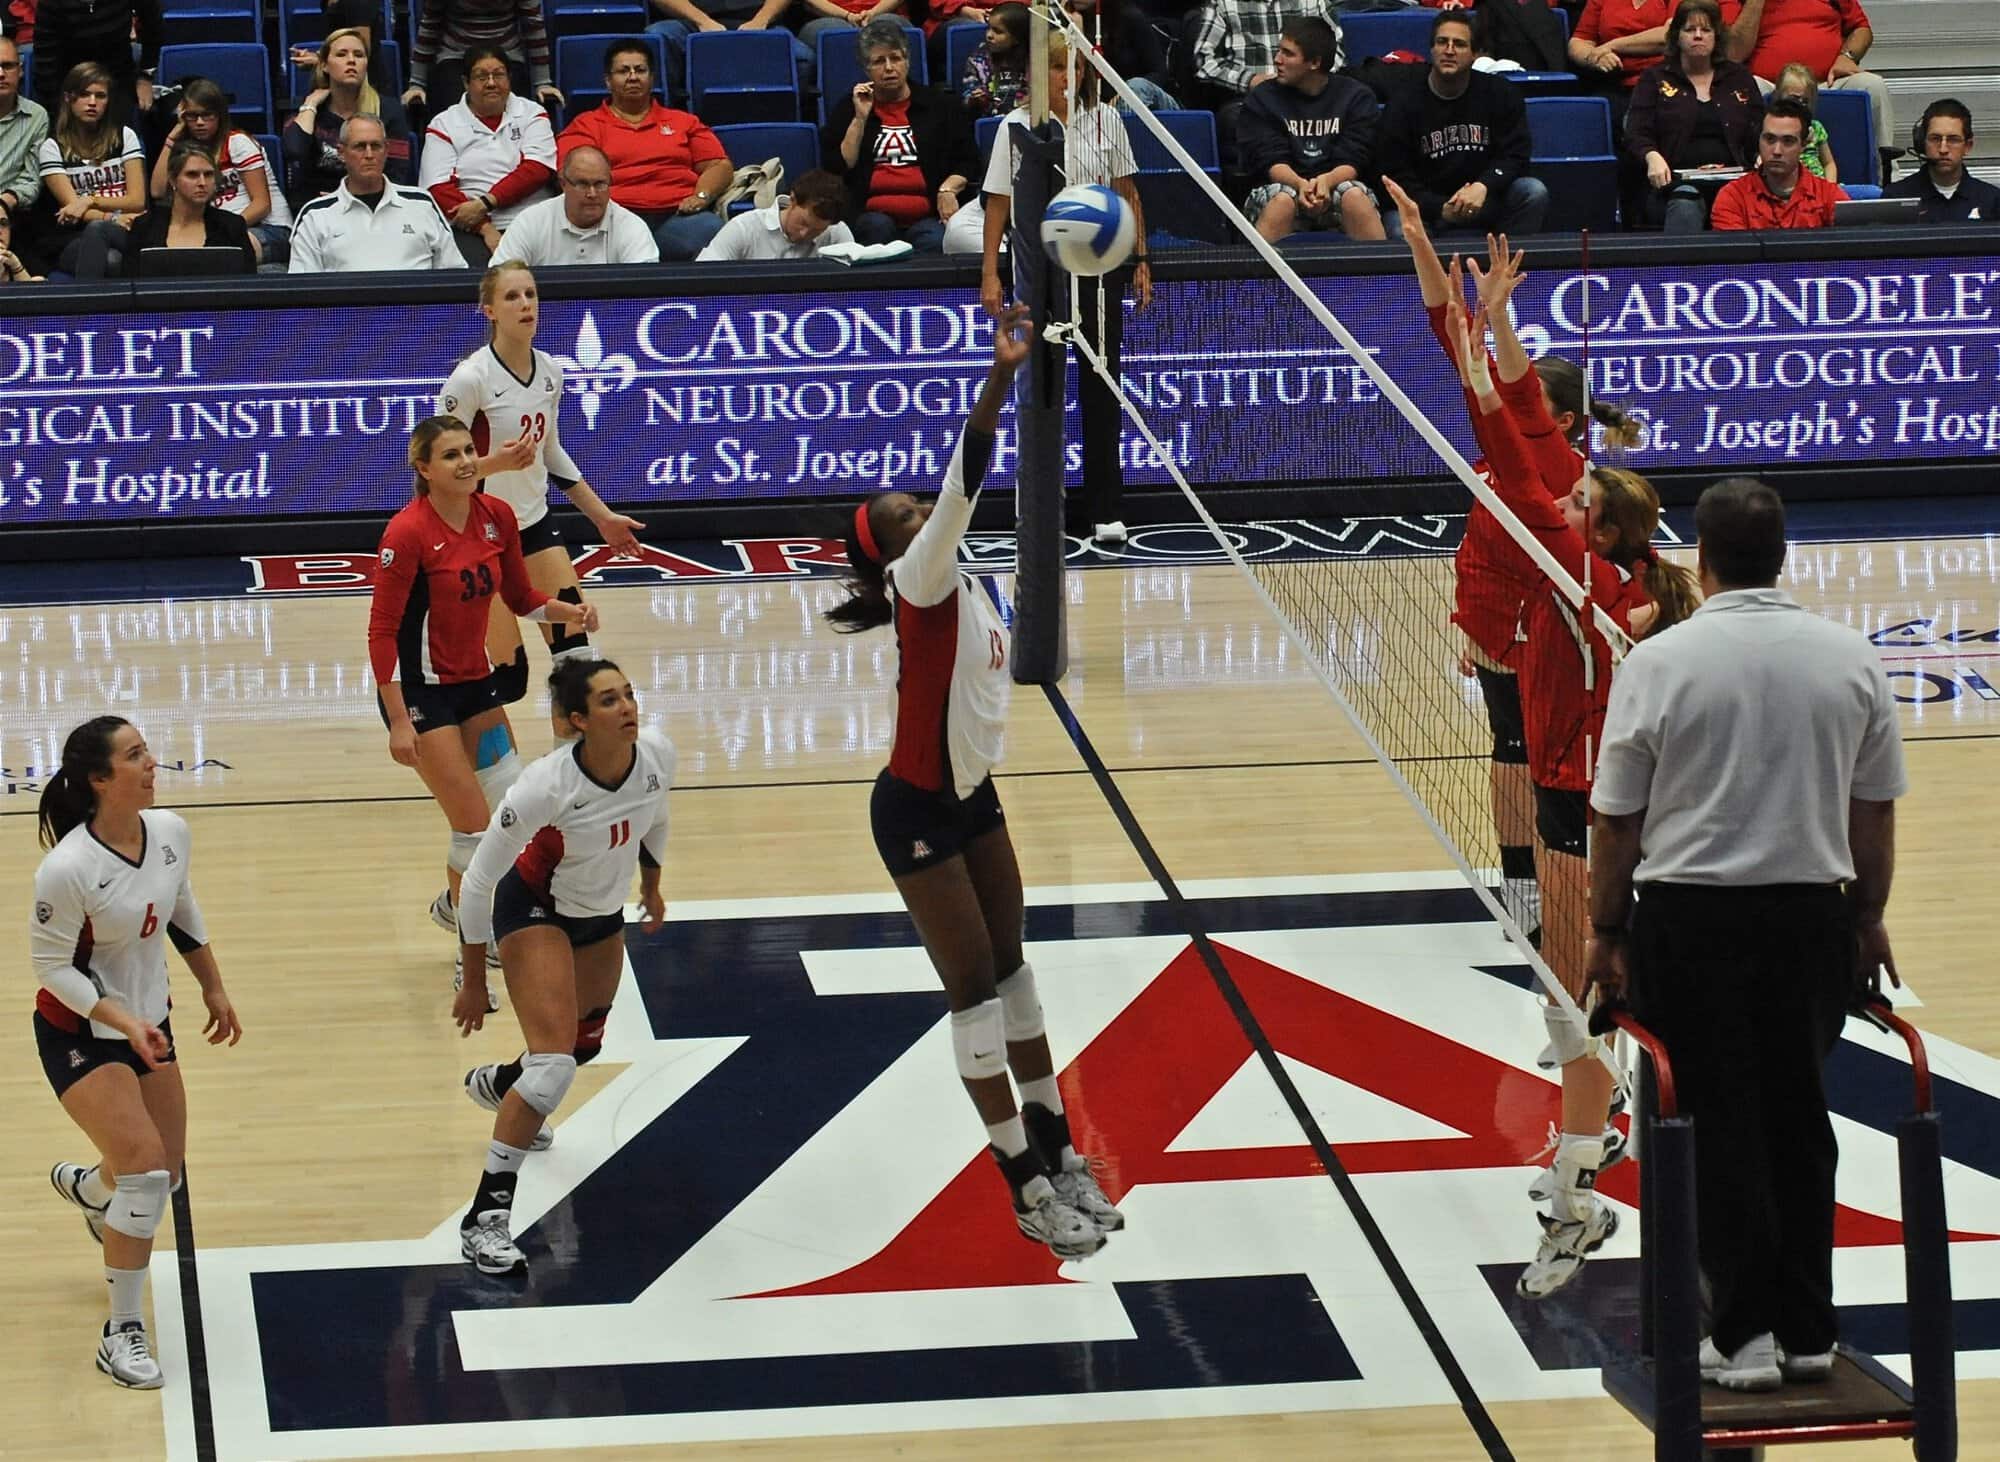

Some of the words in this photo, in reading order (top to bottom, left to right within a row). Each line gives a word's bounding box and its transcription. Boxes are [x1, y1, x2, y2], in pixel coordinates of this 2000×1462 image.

[1120, 365, 1381, 408] NSTITUTE
[167, 394, 443, 441] INSTITUT
[520, 412, 545, 444] 23
[1695, 400, 1876, 456] Joseph's
[647, 451, 695, 486] at
[712, 438, 771, 484] St.
[786, 430, 954, 489] Joseph'
[62, 454, 272, 511] Hospital
[240, 537, 852, 594] BAR
[460, 563, 494, 602] 33
[607, 818, 630, 850] 11
[140, 902, 158, 939] 6
